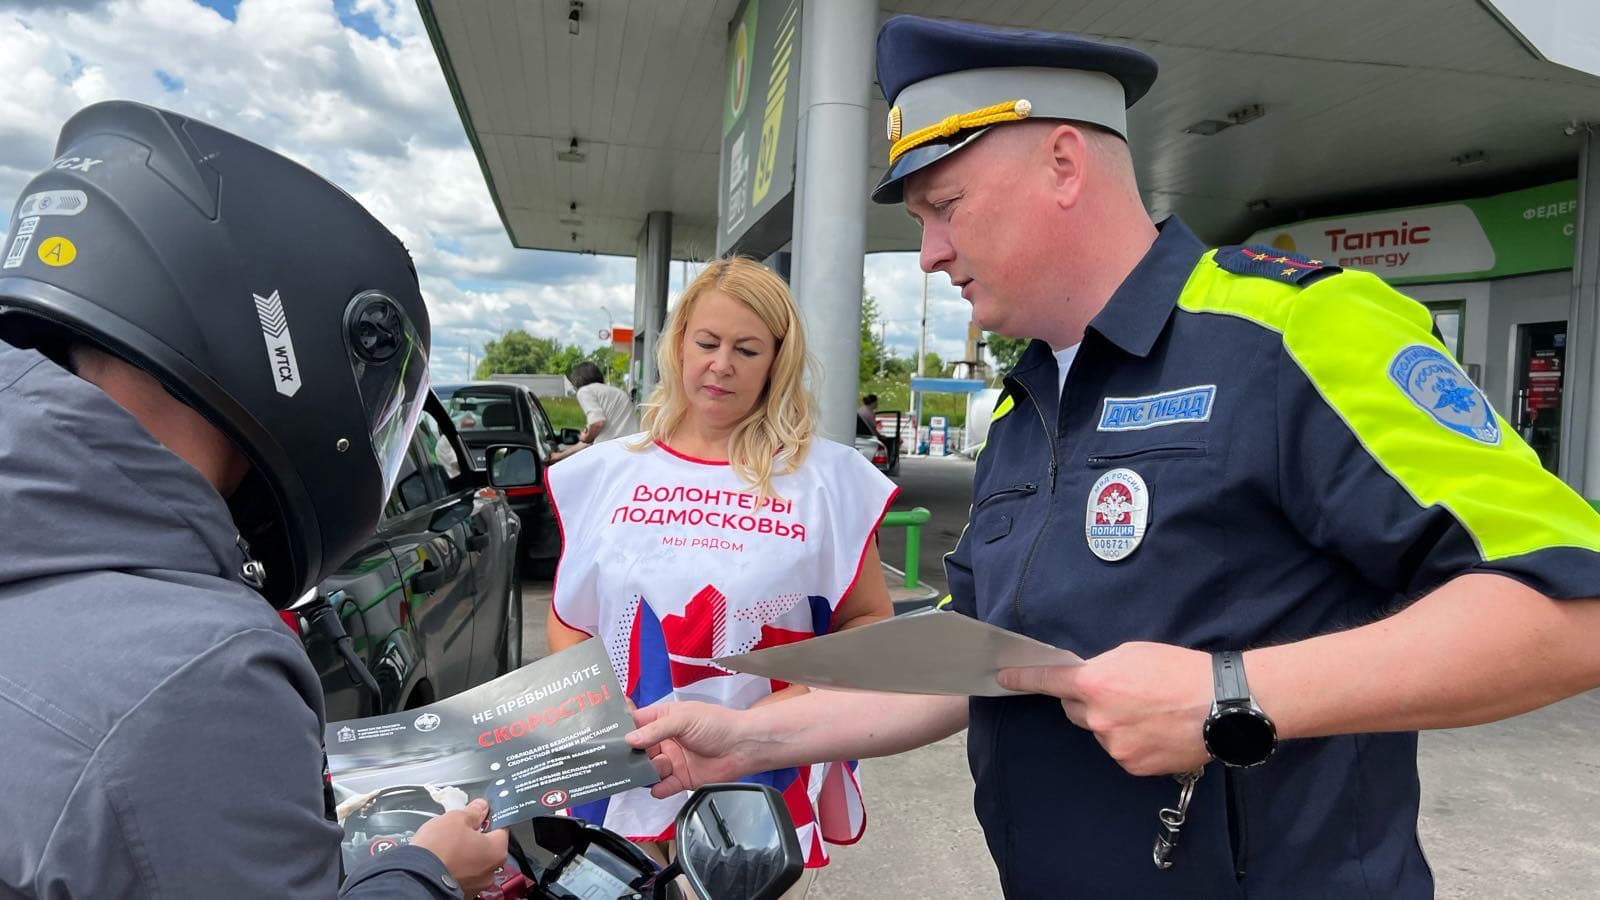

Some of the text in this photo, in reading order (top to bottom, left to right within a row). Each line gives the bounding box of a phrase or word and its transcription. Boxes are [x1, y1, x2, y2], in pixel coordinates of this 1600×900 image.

[1324, 221, 1431, 252] Tamic
[45, 243, 61, 262] A
[274, 346, 293, 382] WTCX
[1107, 395, 1203, 426] ДПС ГИБДД
[632, 484, 792, 514] ВОЛОНТЕРЫ
[611, 506, 806, 542] ПОДМОСКОВЬЯ
[1091, 526, 1134, 536] ПОЛИЦИЯ
[662, 536, 744, 552] МЫ РЯДОМ
[472, 663, 601, 725] НЕ ПРЕВЫШАЙТЕ
[478, 683, 612, 748] СКОРОСТЬ!
[506, 743, 550, 761] СОБЛЮДАЙТЕ
[507, 750, 551, 767] СКОРОСТНОЙ
